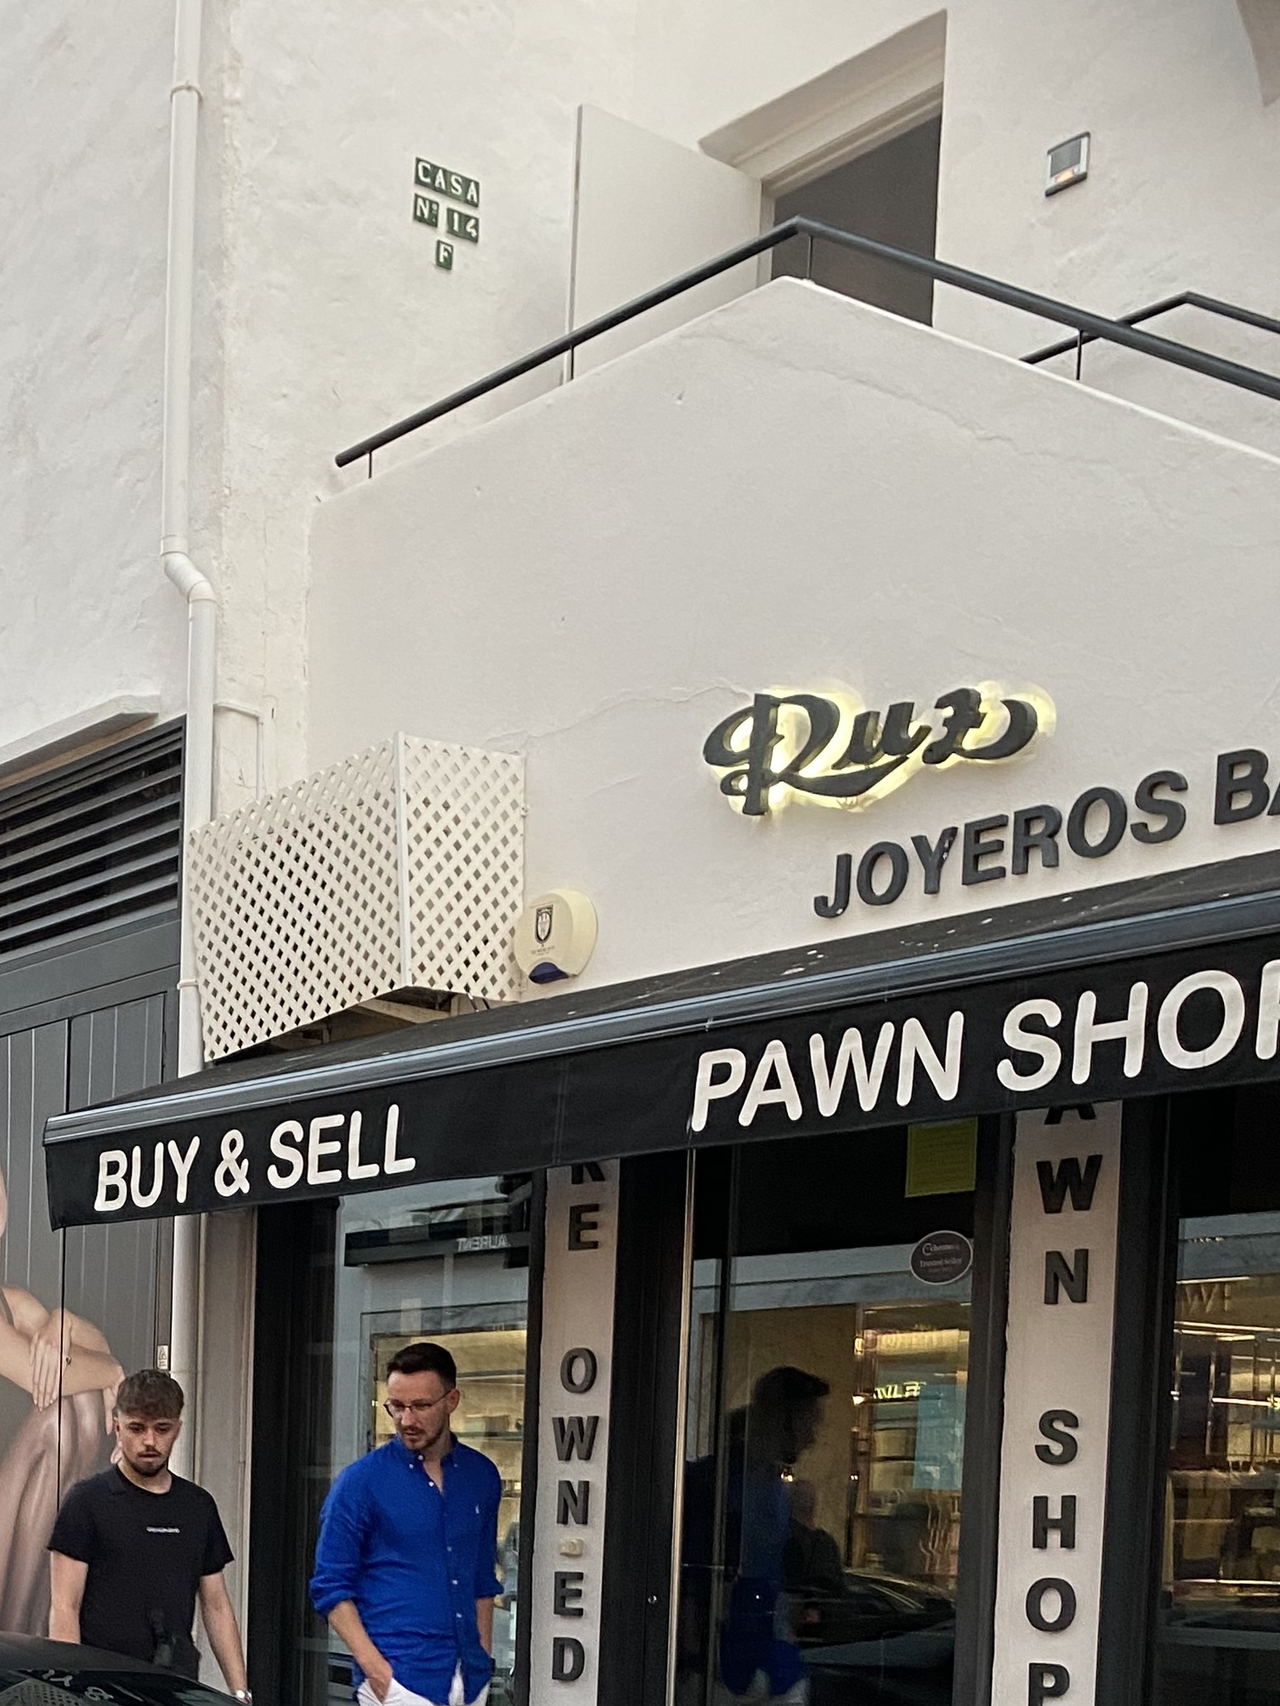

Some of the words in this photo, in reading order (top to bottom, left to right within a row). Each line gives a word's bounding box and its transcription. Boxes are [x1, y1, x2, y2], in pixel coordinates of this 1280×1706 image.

[418, 161, 477, 203] CASA
[453, 212, 477, 237] 14
[440, 243, 452, 263] F
[813, 770, 1189, 919] JOYEROS
[1214, 748, 1280, 825] B
[691, 1011, 965, 1132] PAWN
[93, 1135, 201, 1212] BUY
[214, 1129, 251, 1197] &
[267, 1104, 416, 1189] SELL
[551, 1347, 600, 1682] OWNED
